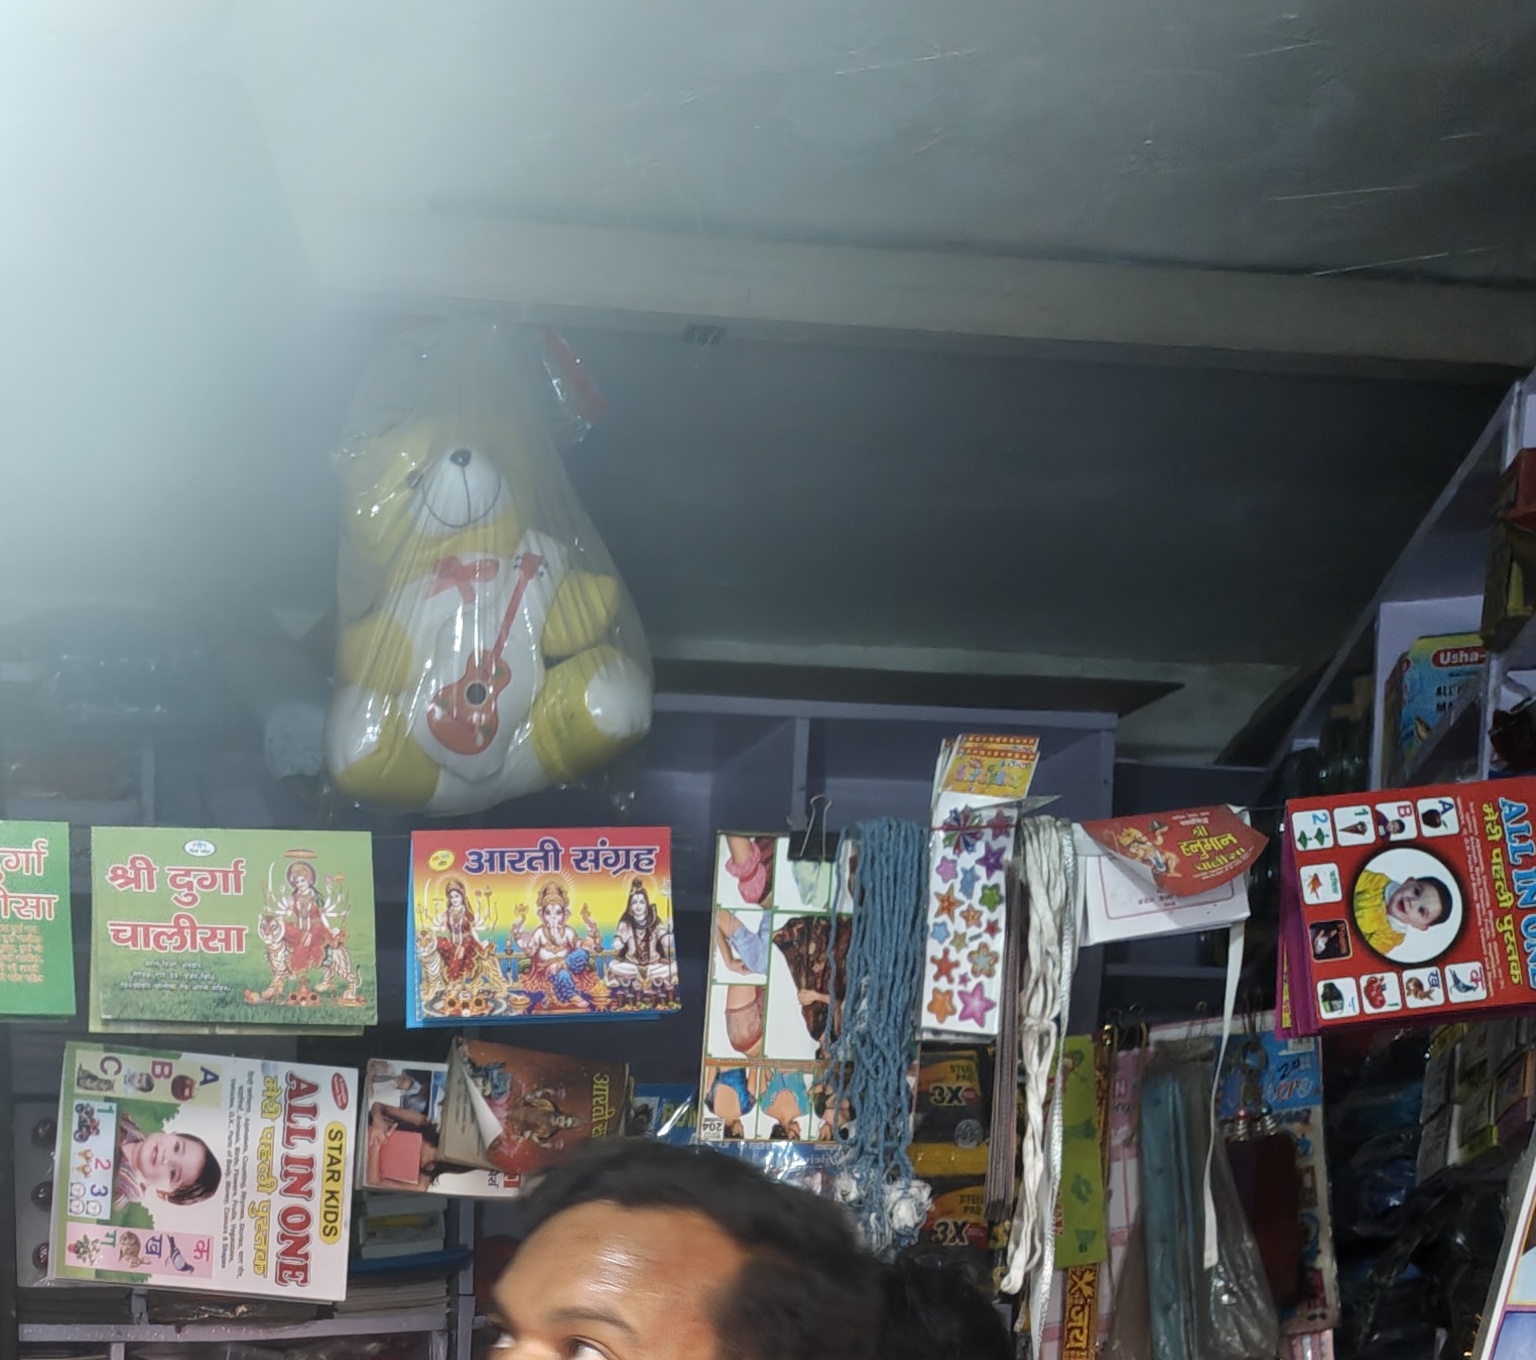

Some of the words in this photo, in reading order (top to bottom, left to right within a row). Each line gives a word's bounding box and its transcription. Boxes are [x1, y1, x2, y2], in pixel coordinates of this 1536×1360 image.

[1311, 812, 1327, 824] 2
[1353, 809, 1368, 818] 1
[1396, 805, 1412, 818] B
[1439, 800, 1455, 815] A
[1482, 801, 1503, 842] मेरी
[1177, 832, 1239, 862] हनुमान
[1498, 795, 1536, 866] ALL
[463, 837, 565, 876] आरती
[572, 835, 660, 877] संग्रह
[106, 853, 159, 893] श्री
[165, 857, 246, 908] दुर्गा
[1491, 847, 1515, 908] पहली
[108, 912, 248, 954] चालीसा
[1495, 913, 1524, 986] पुस्तक
[100, 1056, 122, 1075] C
[151, 1061, 172, 1080] B
[199, 1066, 219, 1086] A
[96, 1106, 114, 1114] 1
[260, 1073, 283, 1121] मेरी
[282, 1069, 322, 1151] ALL
[929, 1084, 965, 1107] 3X
[94, 1158, 111, 1170] 2
[256, 1125, 279, 1196] पहली
[326, 1127, 345, 1183] STAR
[90, 1184, 108, 1197] 3
[279, 1152, 317, 1203] IN
[322, 1189, 342, 1238] KIDS
[101, 1230, 117, 1247] ग
[145, 1234, 162, 1258] ख
[193, 1237, 211, 1261] क
[248, 1200, 272, 1280] पुस्तक
[274, 1203, 315, 1288] ONE
[933, 1221, 969, 1246] 3X
[1065, 1298, 1092, 1351] जय
